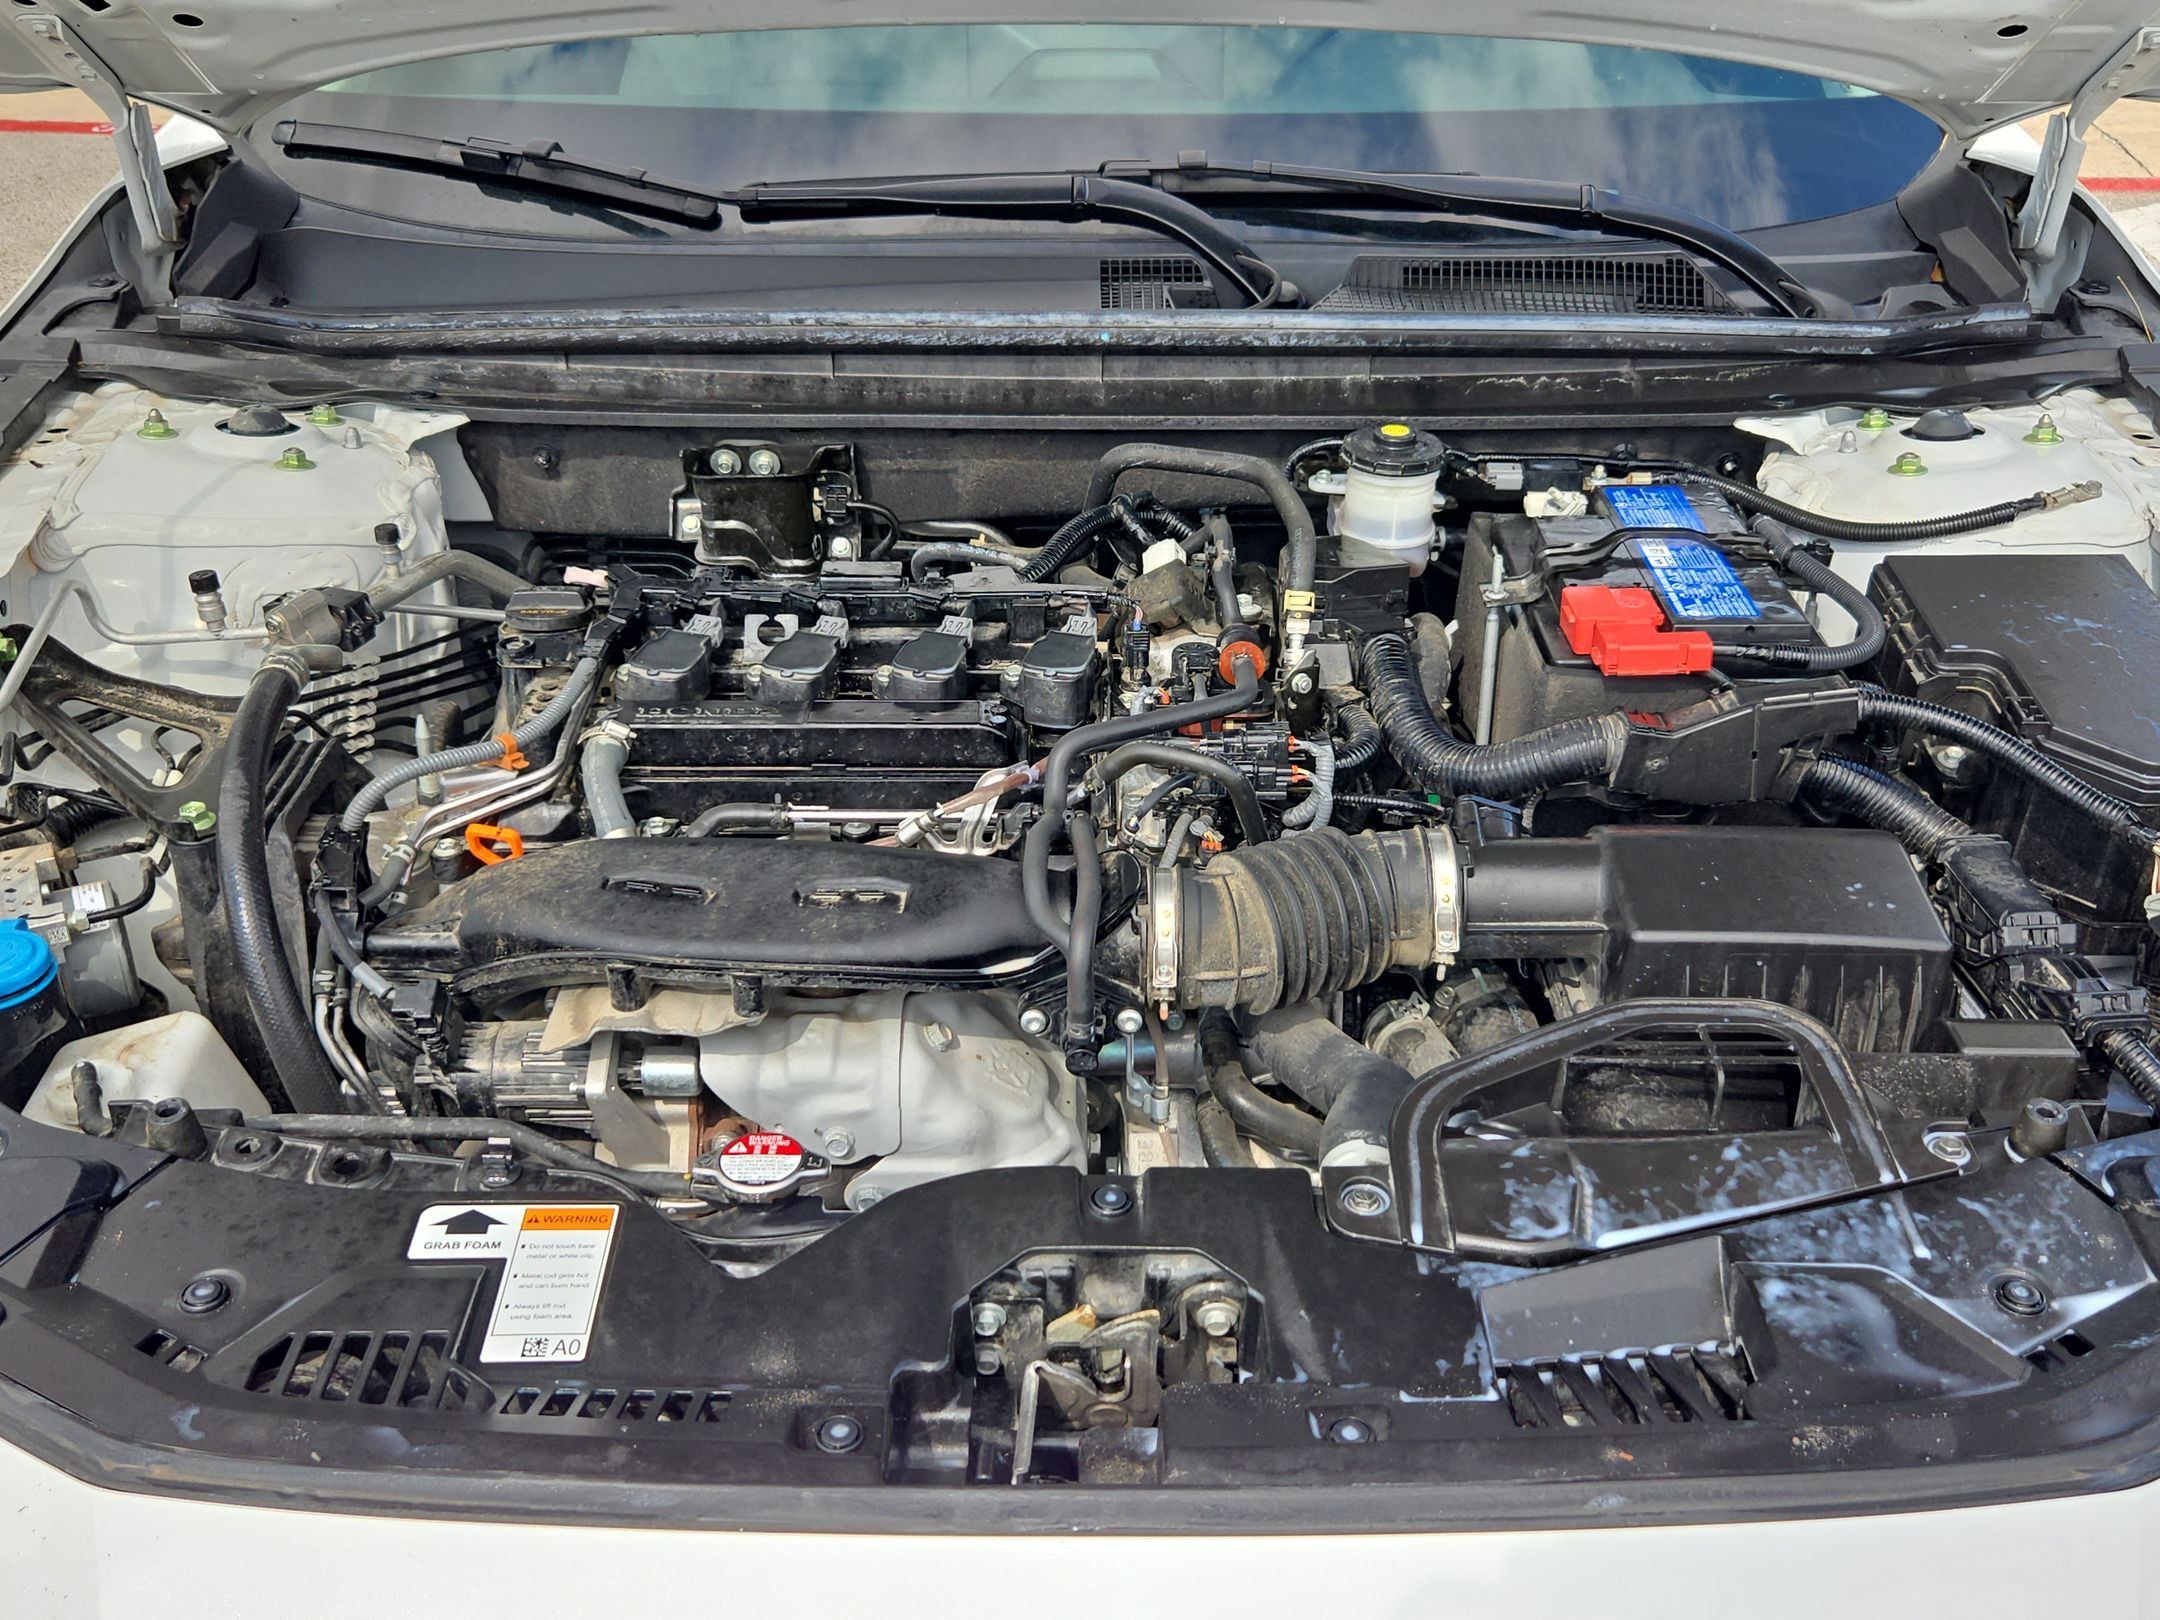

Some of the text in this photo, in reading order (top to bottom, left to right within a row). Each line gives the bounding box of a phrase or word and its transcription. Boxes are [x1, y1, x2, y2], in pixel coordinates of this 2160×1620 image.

[542, 1215, 609, 1224] WARNING
[423, 1241, 502, 1250] GRAB FOAM
[551, 1338, 581, 1355] A0
